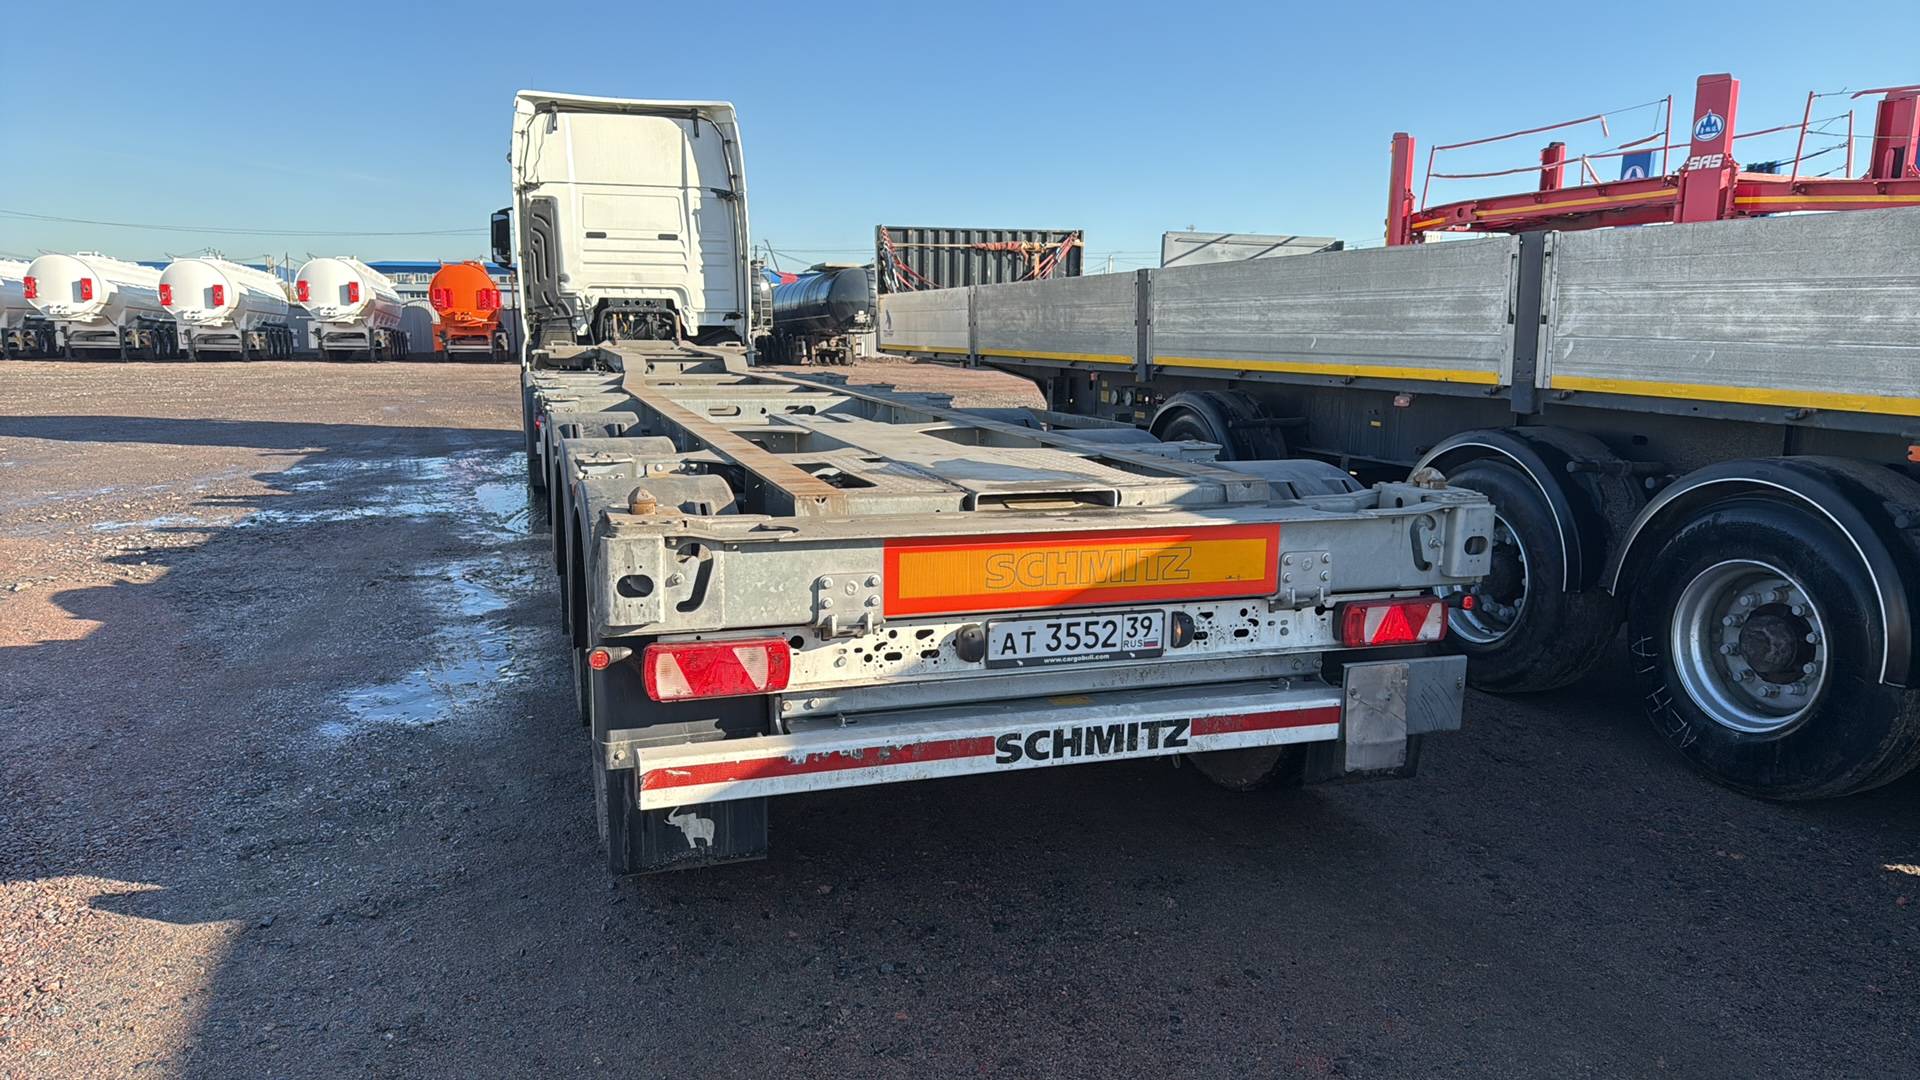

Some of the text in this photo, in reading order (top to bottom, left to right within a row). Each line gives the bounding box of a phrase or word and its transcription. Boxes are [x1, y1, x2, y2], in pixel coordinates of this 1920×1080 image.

[1688, 153, 1724, 171] SAS
[985, 547, 1193, 590] SCHMITZ
[1045, 619, 1118, 652] 3552
[1126, 616, 1153, 638] 39
[1123, 639, 1143, 649] RUS
[1043, 652, 1110, 664] www.cargobull.com
[995, 718, 1190, 764] SCHMITZ
